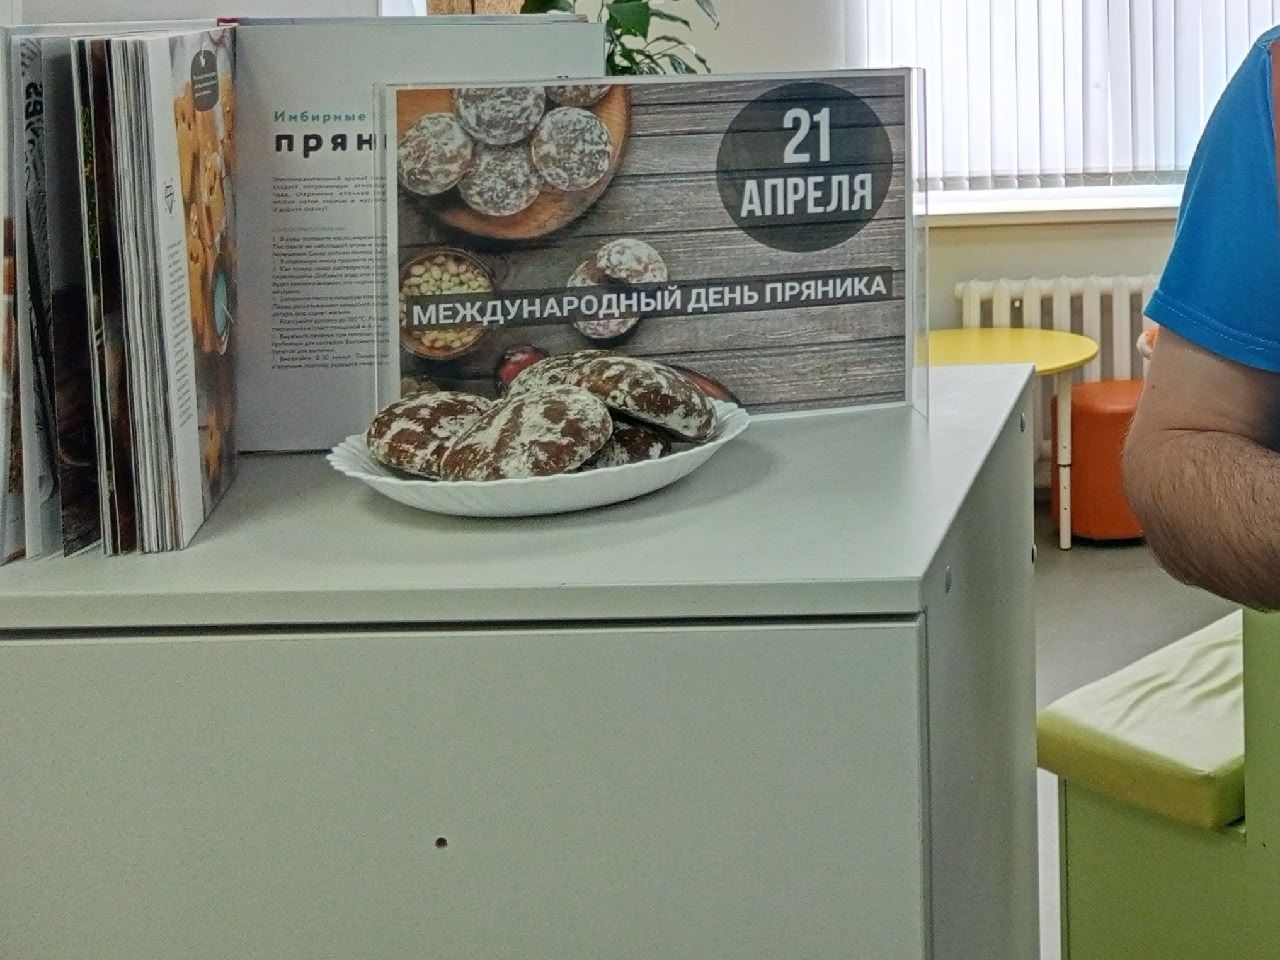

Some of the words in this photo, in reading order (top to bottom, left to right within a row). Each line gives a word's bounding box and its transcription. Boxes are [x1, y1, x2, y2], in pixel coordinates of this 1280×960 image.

[274, 110, 366, 124] Имбирные
[783, 107, 831, 164] 21
[275, 133, 387, 159] прян
[740, 173, 873, 218] АПРЕЛЯ
[412, 284, 682, 327] МЕЖДУНАРОДНЫЙ
[687, 285, 759, 313] ДЕНЬ
[765, 275, 888, 304] ПРЯНИКА
